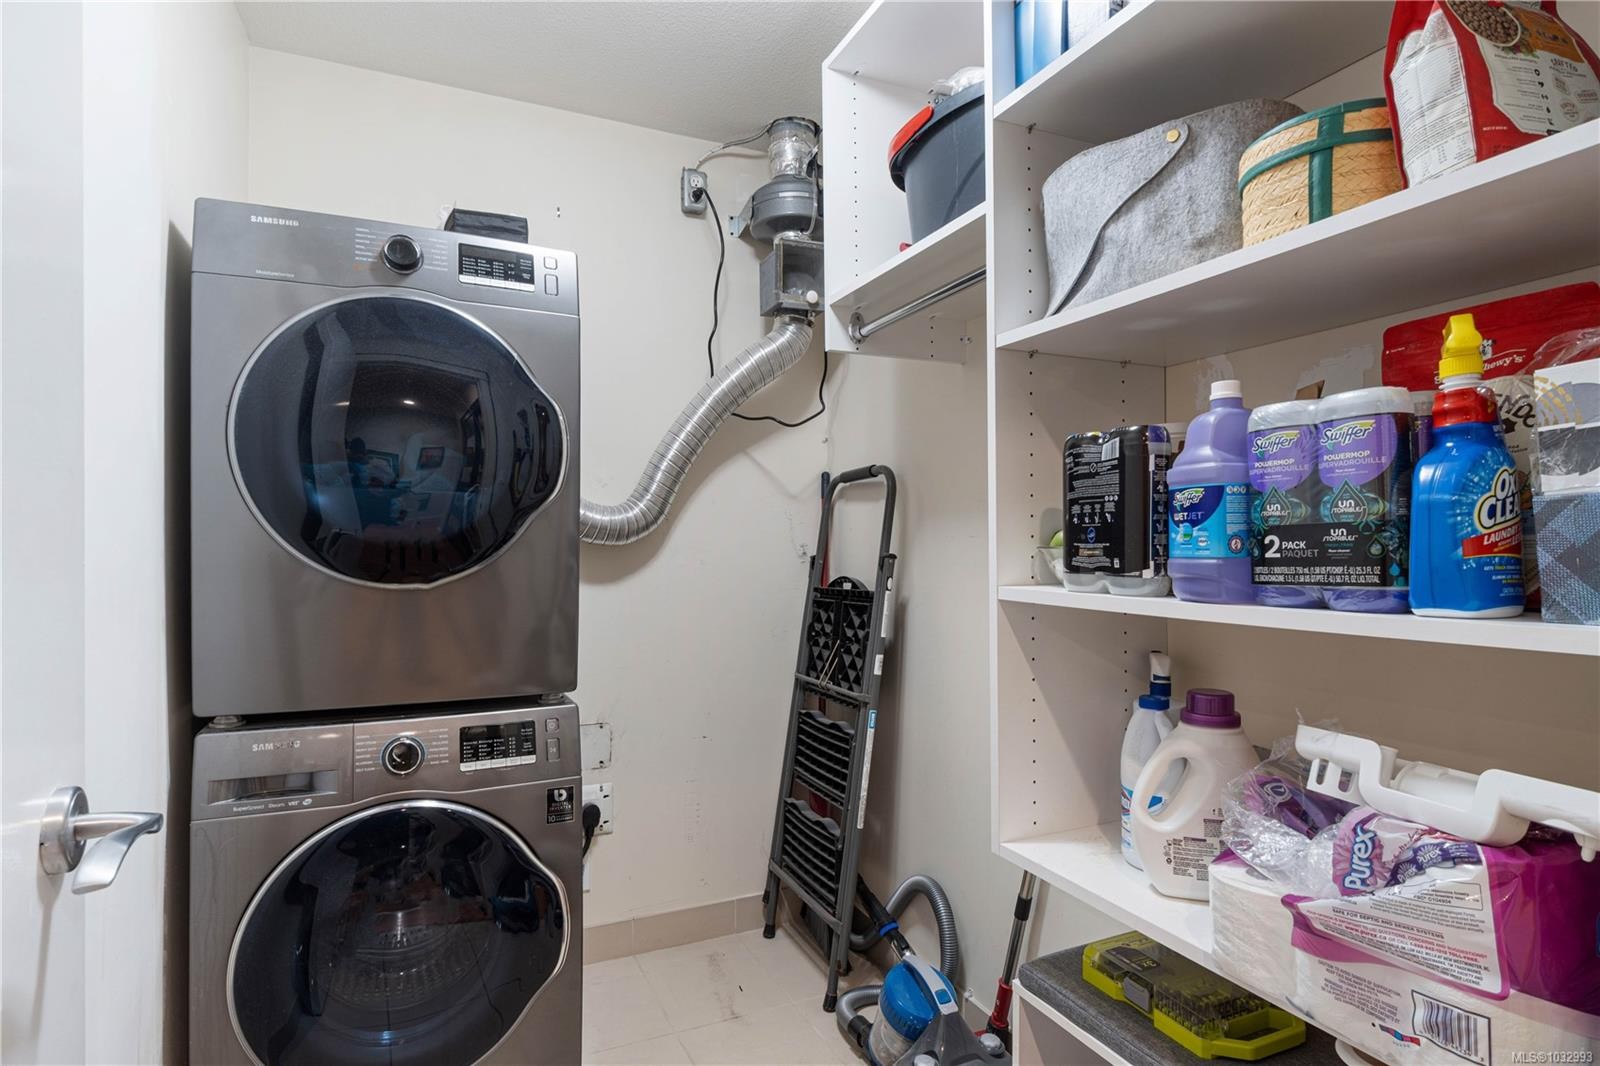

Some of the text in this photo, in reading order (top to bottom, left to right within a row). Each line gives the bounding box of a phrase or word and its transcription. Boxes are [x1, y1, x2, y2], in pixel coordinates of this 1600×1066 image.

[250, 215, 300, 227] SAMSUNG
[1482, 354, 1523, 371] hewy's
[1320, 424, 1374, 446] Swiffer
[1252, 436, 1299, 455] Swiffer
[1254, 458, 1296, 469] POWERMOP
[1323, 450, 1370, 462] POWERMOP
[1173, 489, 1205, 508] Swiffer
[1480, 494, 1520, 527] CLEA
[1264, 535, 1307, 558] 2 PACK
[1282, 549, 1319, 559] PAQUET
[1343, 823, 1377, 890] Purex
[1416, 848, 1442, 865] Purex
[1360, 914, 1380, 924] SEPTIC
[1381, 919, 1394, 927] AND
[1416, 926, 1445, 940] SYSTEMS
